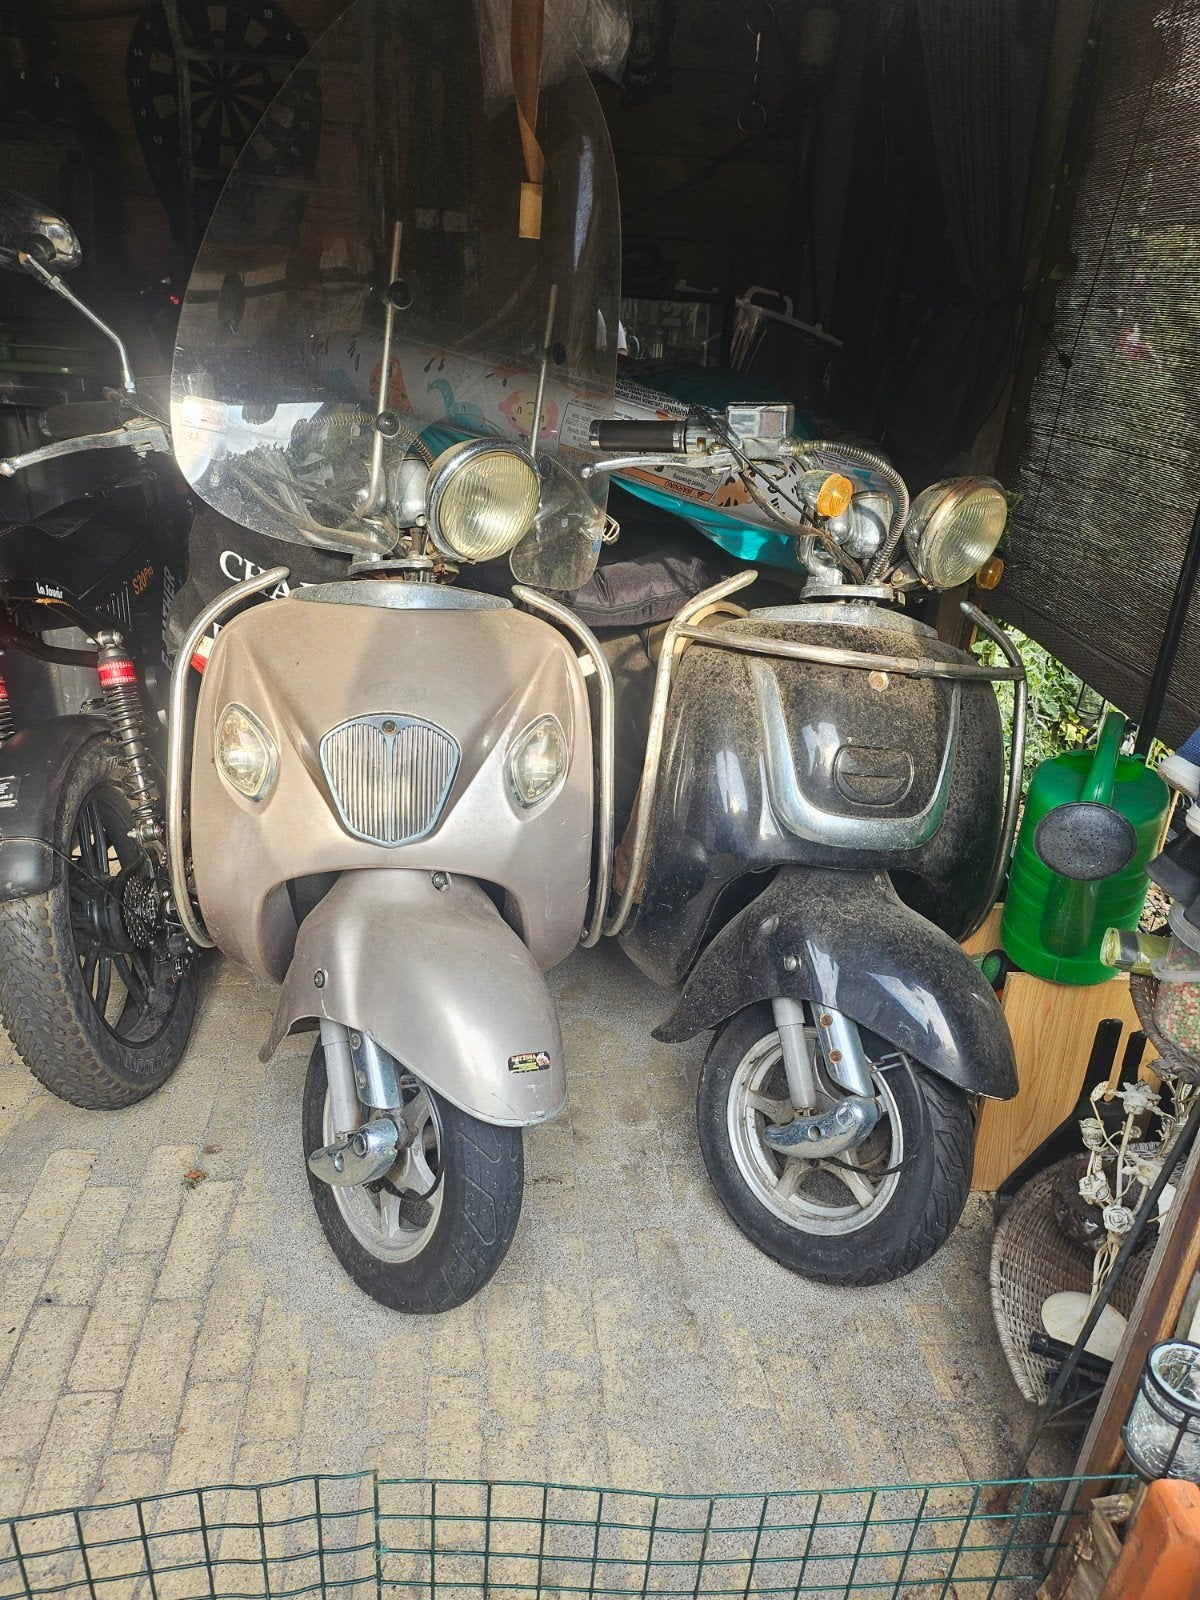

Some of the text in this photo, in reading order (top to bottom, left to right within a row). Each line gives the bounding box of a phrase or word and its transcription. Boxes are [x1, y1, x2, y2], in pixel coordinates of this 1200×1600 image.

[133, 49, 143, 57] 14
[131, 78, 141, 87] 11
[665, 481, 692, 495] WARNING
